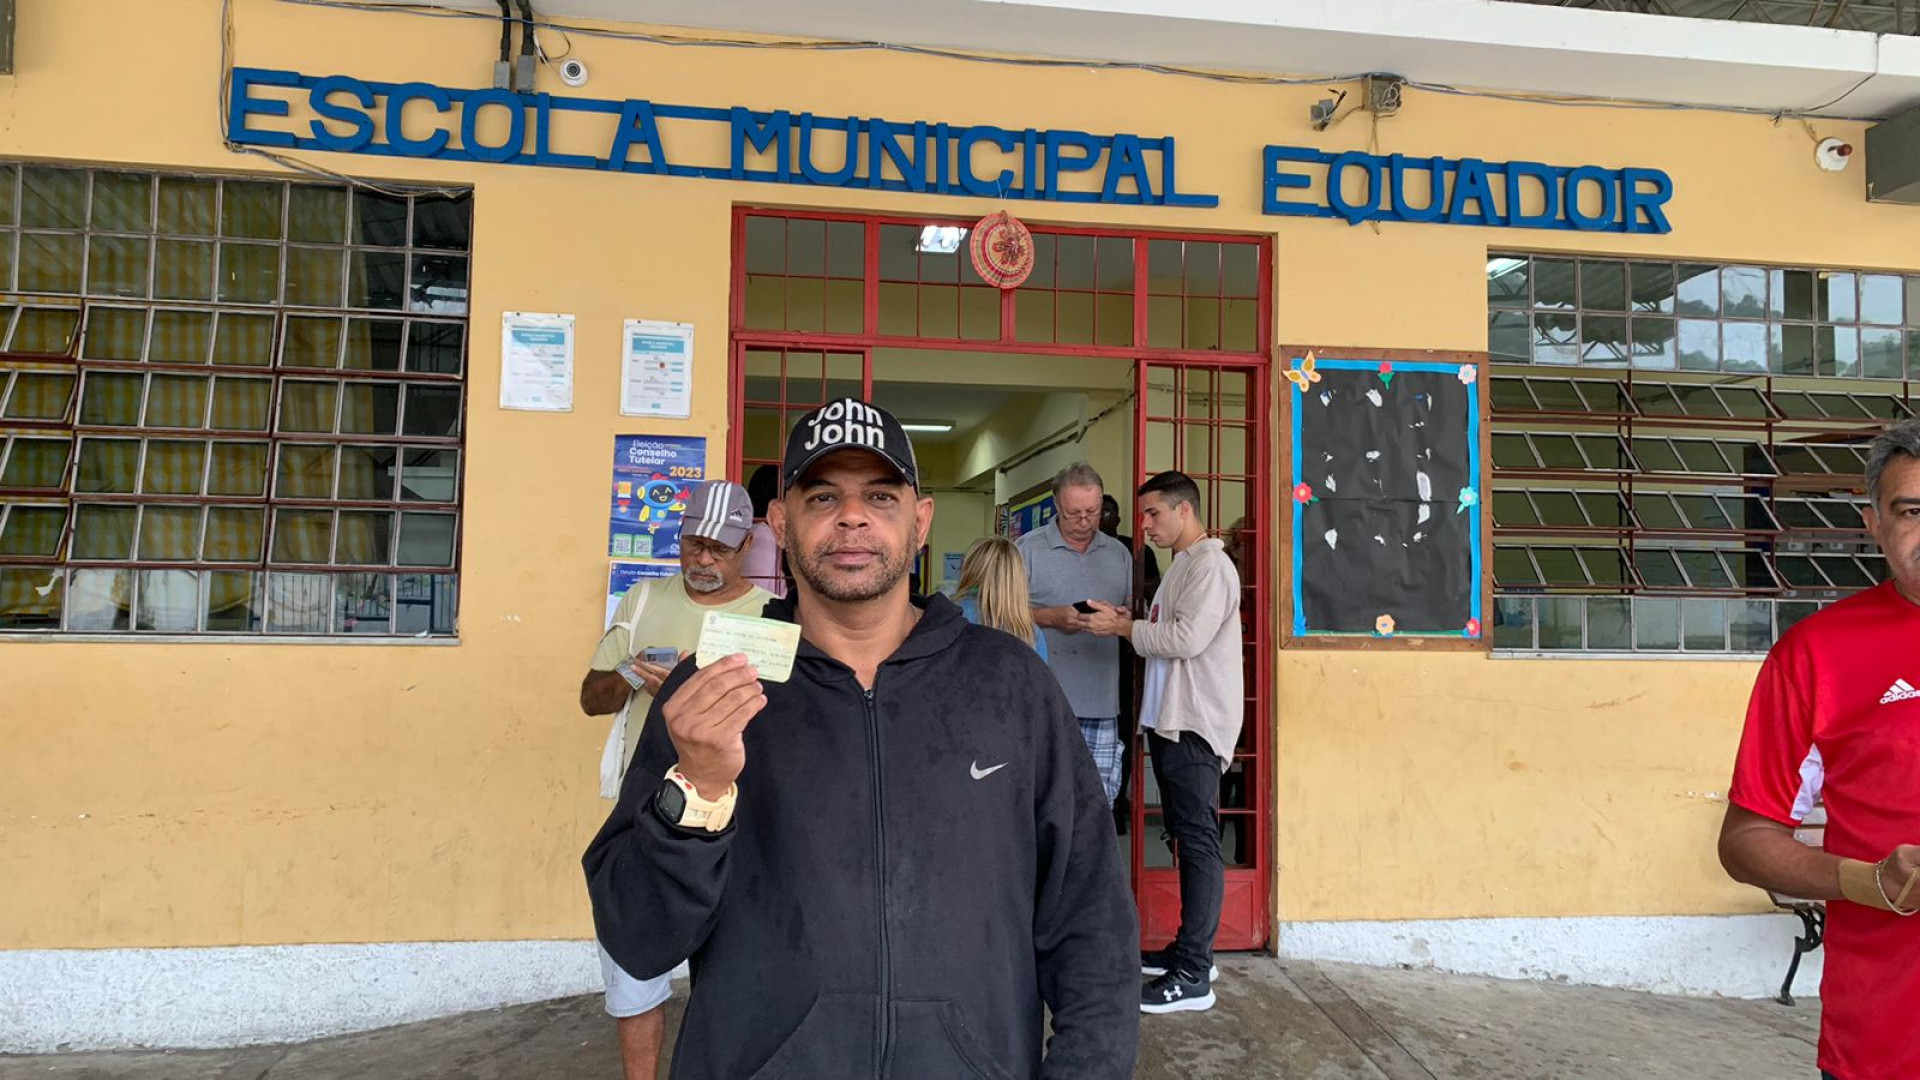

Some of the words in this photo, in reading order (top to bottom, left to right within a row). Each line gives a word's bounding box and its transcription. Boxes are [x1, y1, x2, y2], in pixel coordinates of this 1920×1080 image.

[229, 67, 669, 174] ESCOLA
[730, 106, 1219, 208] MUNICIPAL
[1262, 144, 1673, 234] EQUADOR
[629, 447, 677, 458] Conselho
[629, 455, 666, 466] Tutelar
[669, 465, 702, 478] 2023
